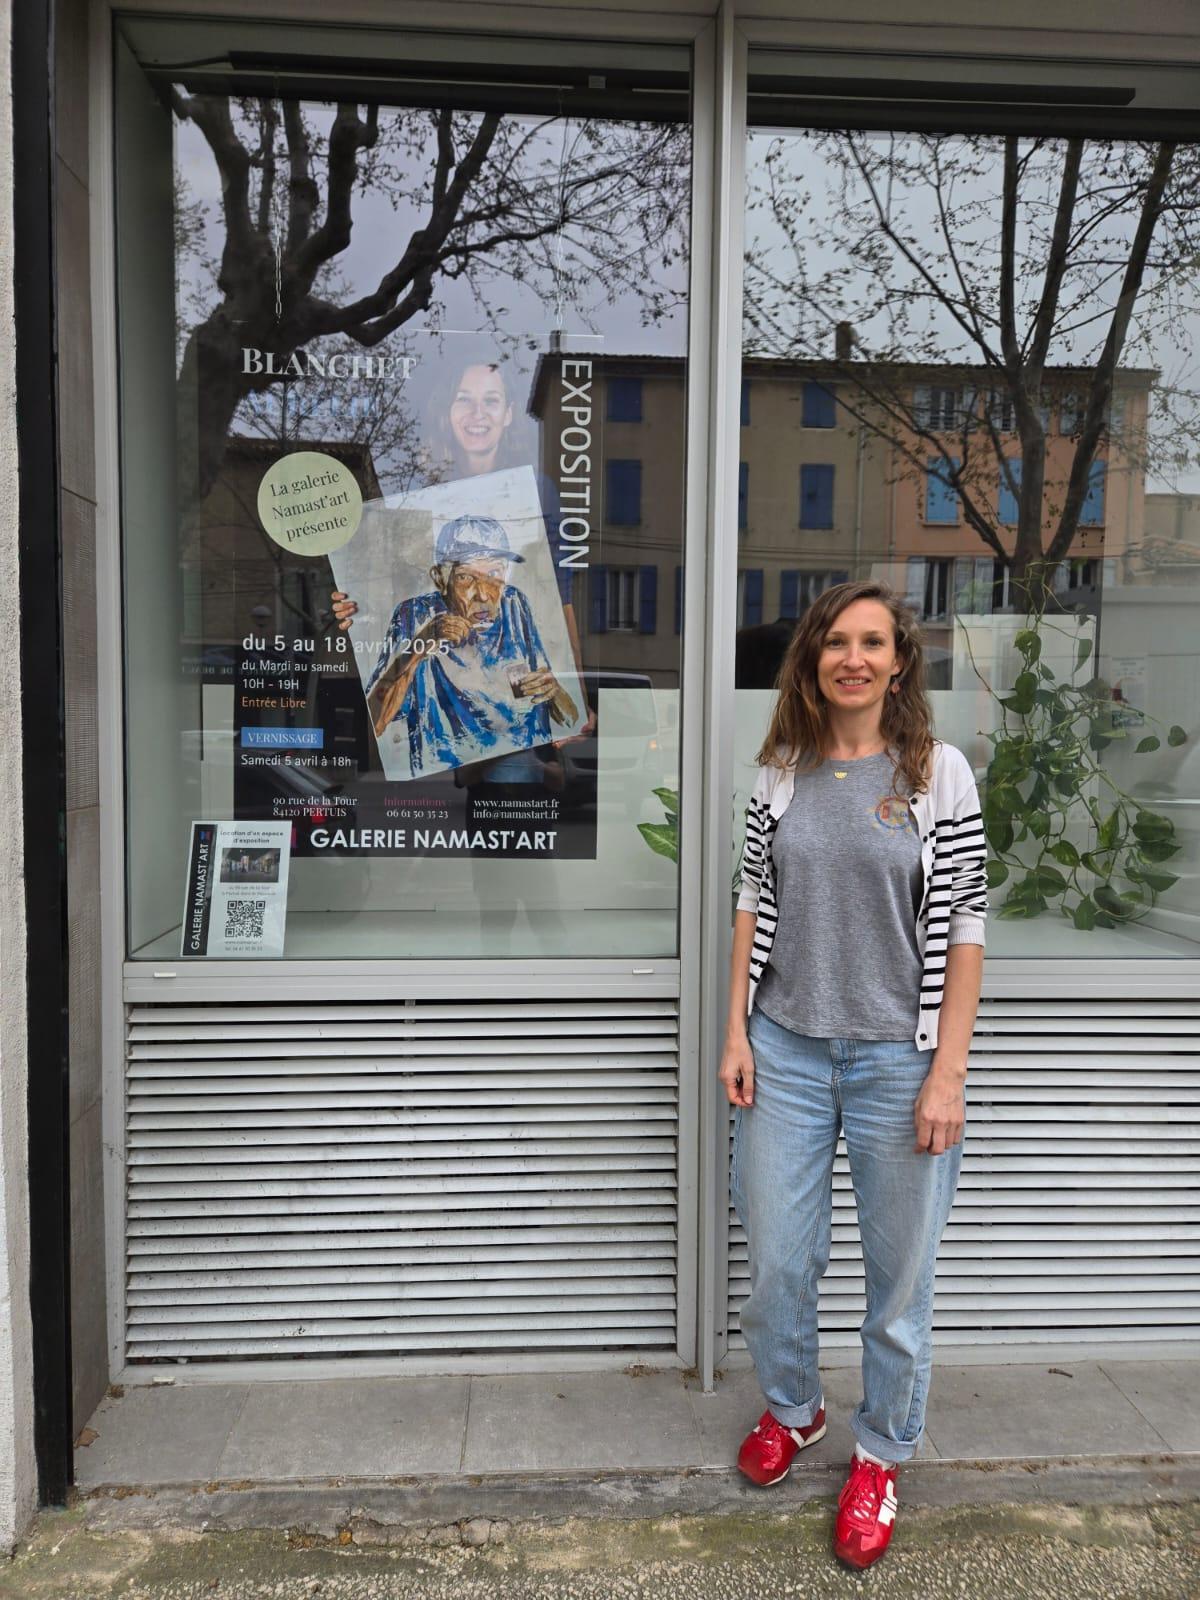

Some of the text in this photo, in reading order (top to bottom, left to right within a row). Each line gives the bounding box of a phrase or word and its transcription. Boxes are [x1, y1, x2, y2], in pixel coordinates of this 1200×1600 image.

[241, 347, 417, 379] BLANCHET
[559, 360, 592, 568] EXPOSITION
[270, 471, 340, 497] La galerie
[286, 516, 349, 542] présente
[242, 633, 450, 655] du 5 au 18 avril 2025
[242, 660, 256, 671] du
[260, 660, 291, 671] Mardi
[294, 663, 307, 672] au
[311, 662, 349, 673] samedi
[242, 679, 265, 689] 10H
[279, 679, 300, 690] 19H
[242, 697, 306, 709] Entrée Libre
[248, 732, 318, 744] VERNISSAGE
[241, 754, 352, 768] Samedi 5 avril à 18h
[272, 796, 358, 807] 90 rue de la Tour
[473, 799, 560, 809] www.namastart.fr
[272, 806, 347, 818] 84120 PERTUIS
[386, 808, 399, 819] 06
[401, 808, 411, 819] 61
[438, 810, 449, 820] 23
[473, 809, 560, 820] info@namastart.fr
[310, 828, 558, 850] GALERIE NAMAST'ART
[191, 908, 203, 950] GALERIE
